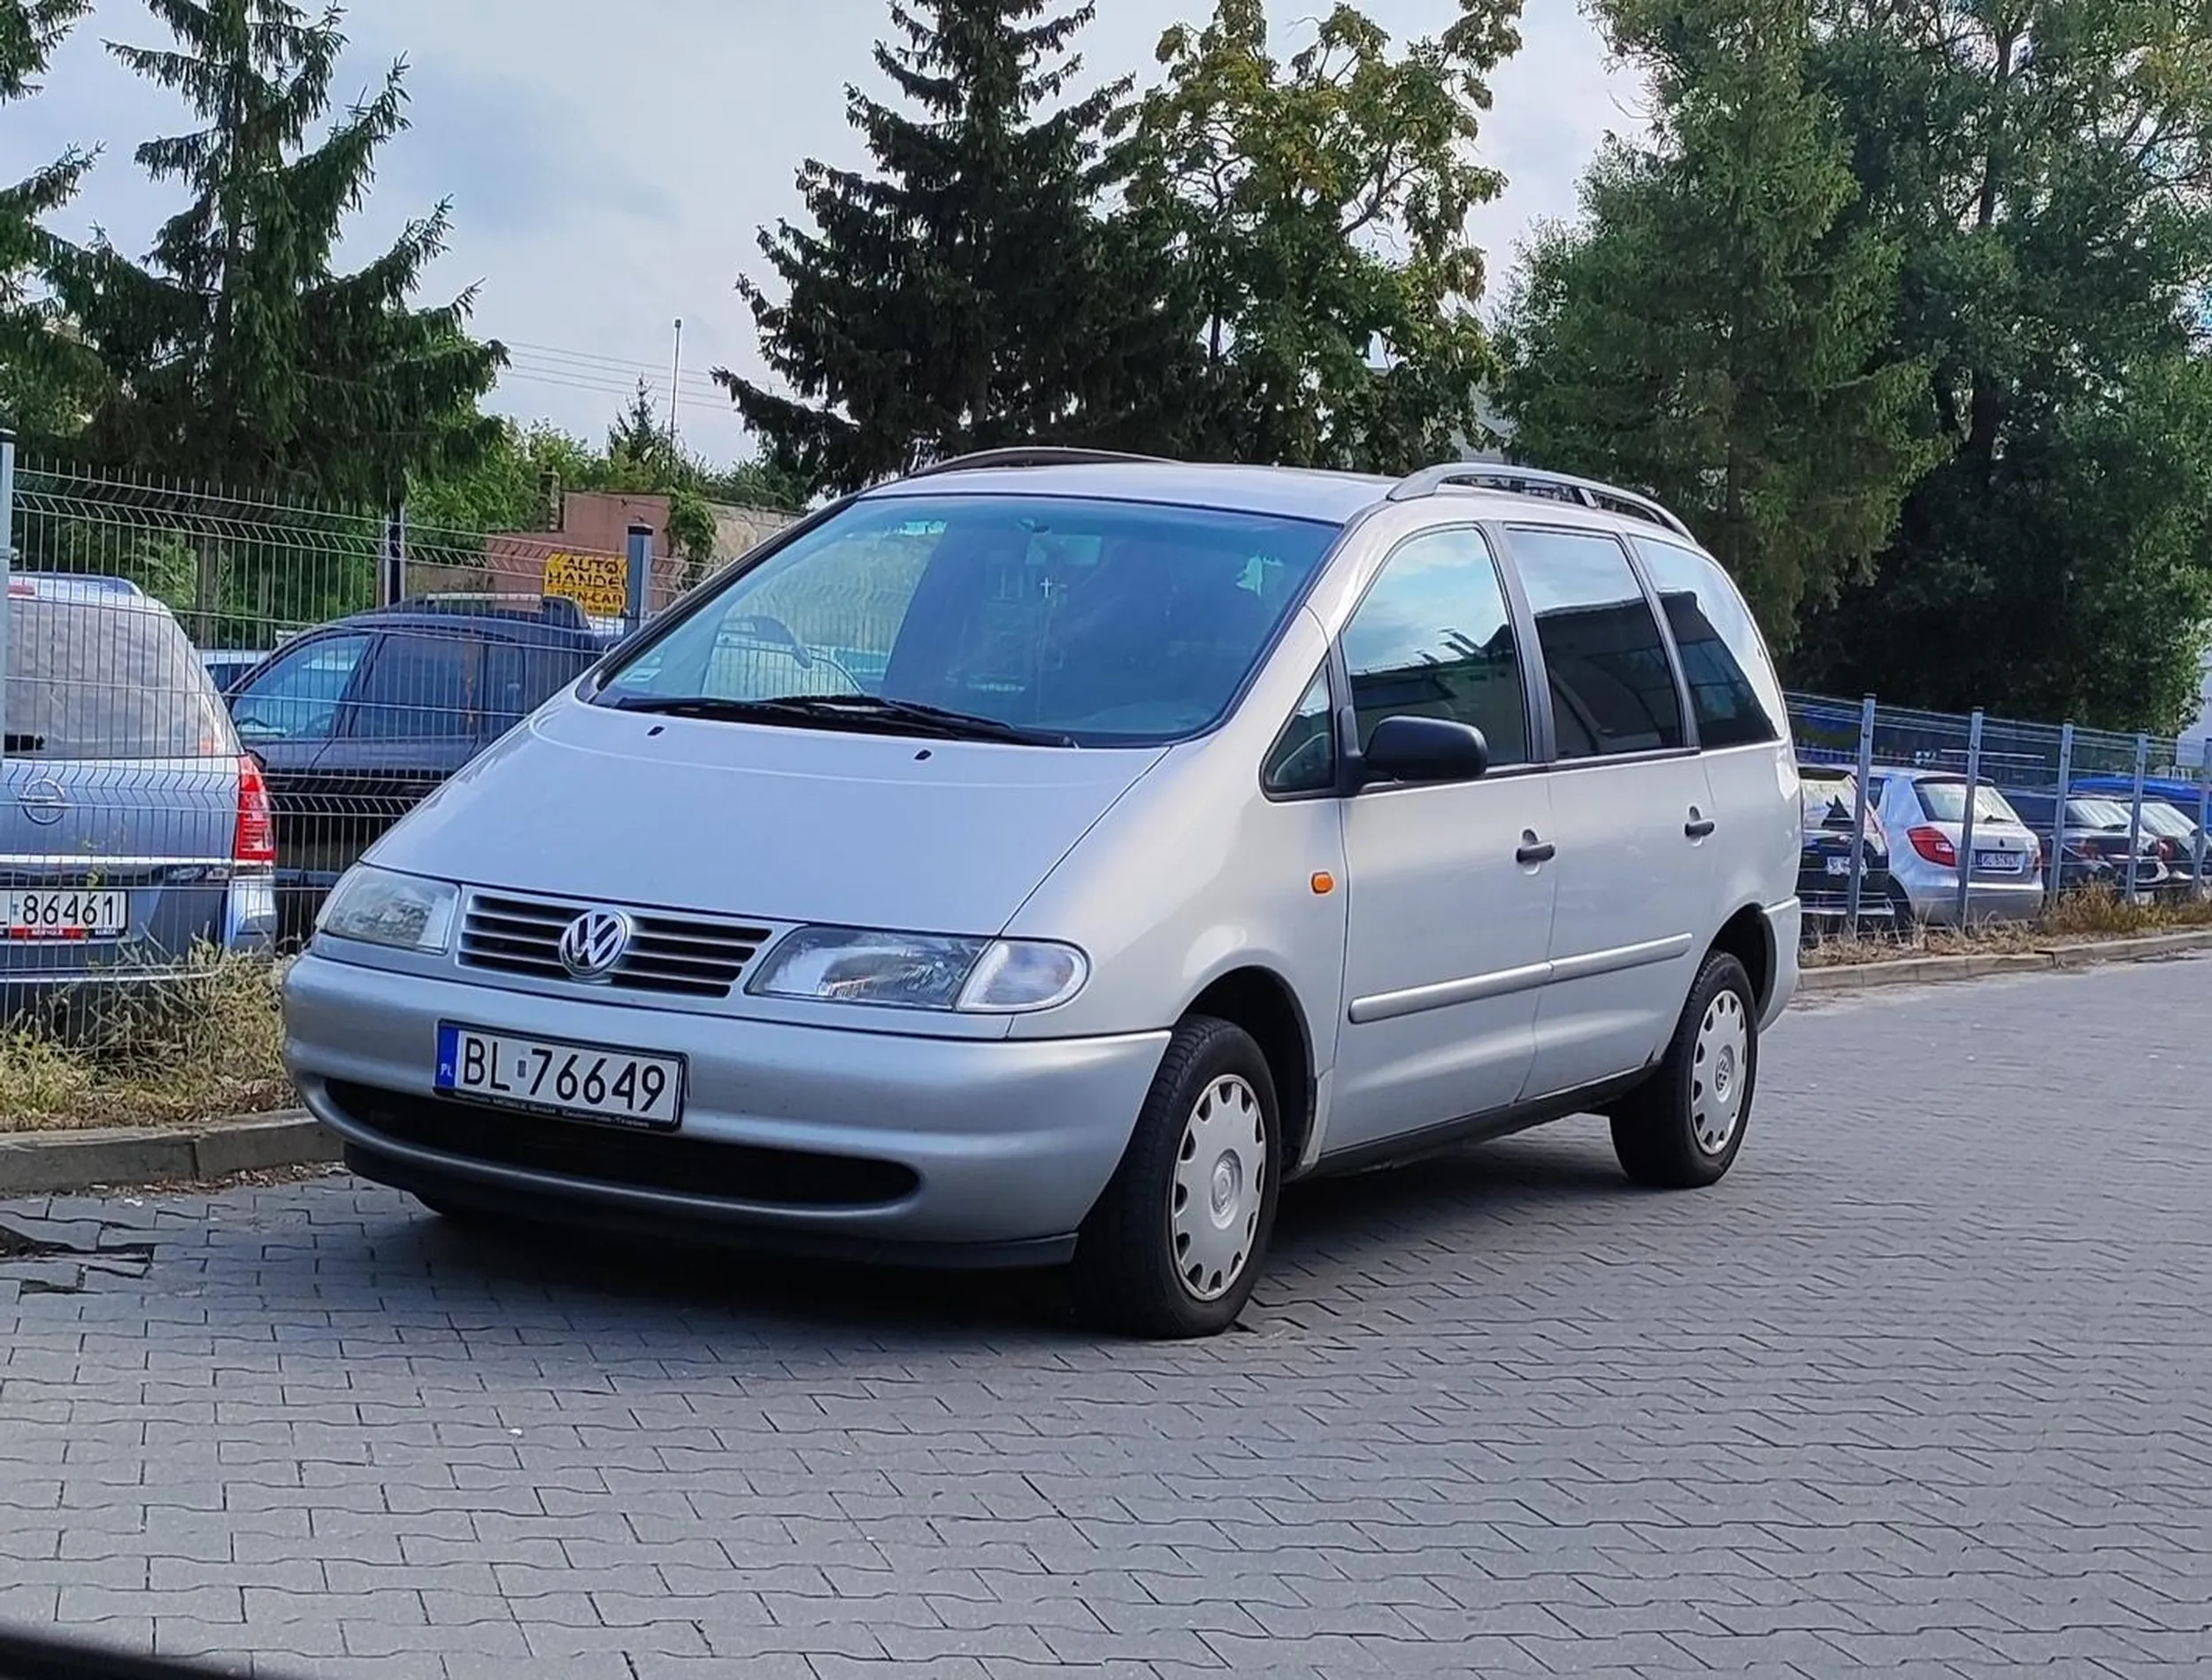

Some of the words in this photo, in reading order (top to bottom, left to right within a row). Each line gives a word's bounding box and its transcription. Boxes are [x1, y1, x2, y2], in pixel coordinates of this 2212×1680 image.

[564, 557, 618, 574] AUTO
[22, 894, 113, 925] 86461
[440, 1063, 453, 1078] PL
[463, 1037, 511, 1092] BL
[529, 1047, 665, 1112] 76649
